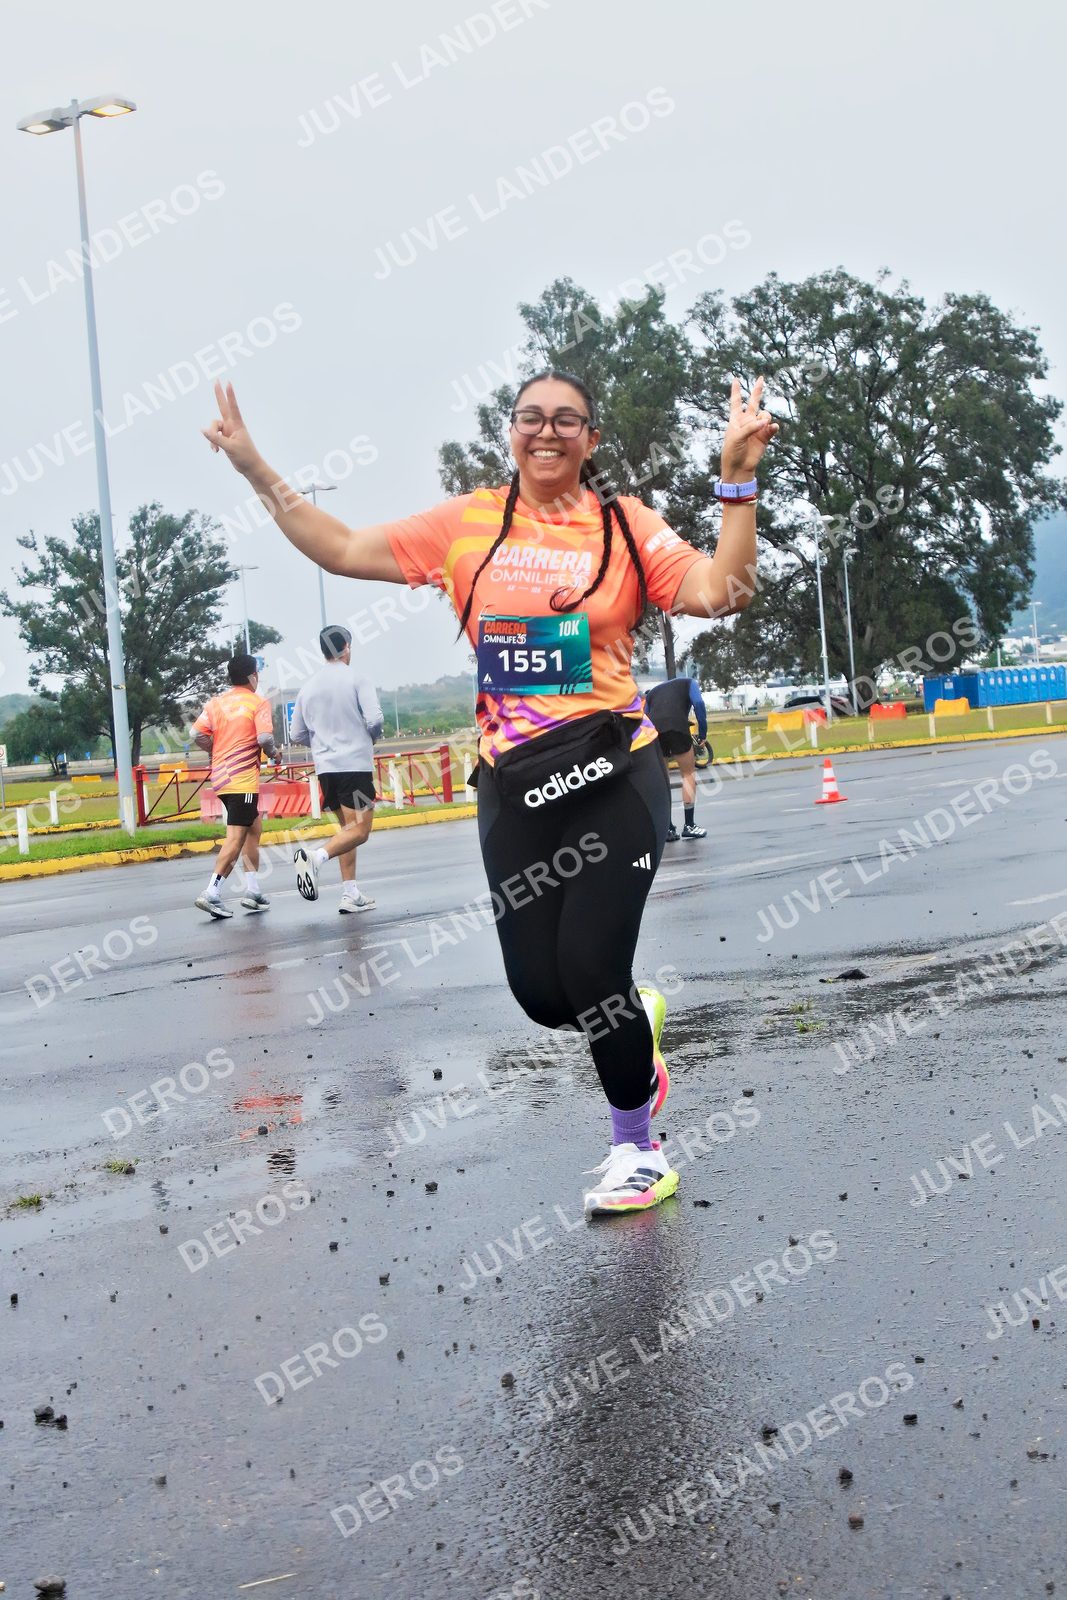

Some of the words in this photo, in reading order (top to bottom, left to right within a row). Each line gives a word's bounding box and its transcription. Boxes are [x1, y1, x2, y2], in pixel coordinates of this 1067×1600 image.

[492, 544, 592, 573] CARRERA
[490, 569, 567, 586] OMNILIFE
[484, 622, 527, 634] CARRERA
[559, 620, 580, 637] 10K
[498, 649, 562, 673] 1551
[524, 757, 614, 808] adidas
